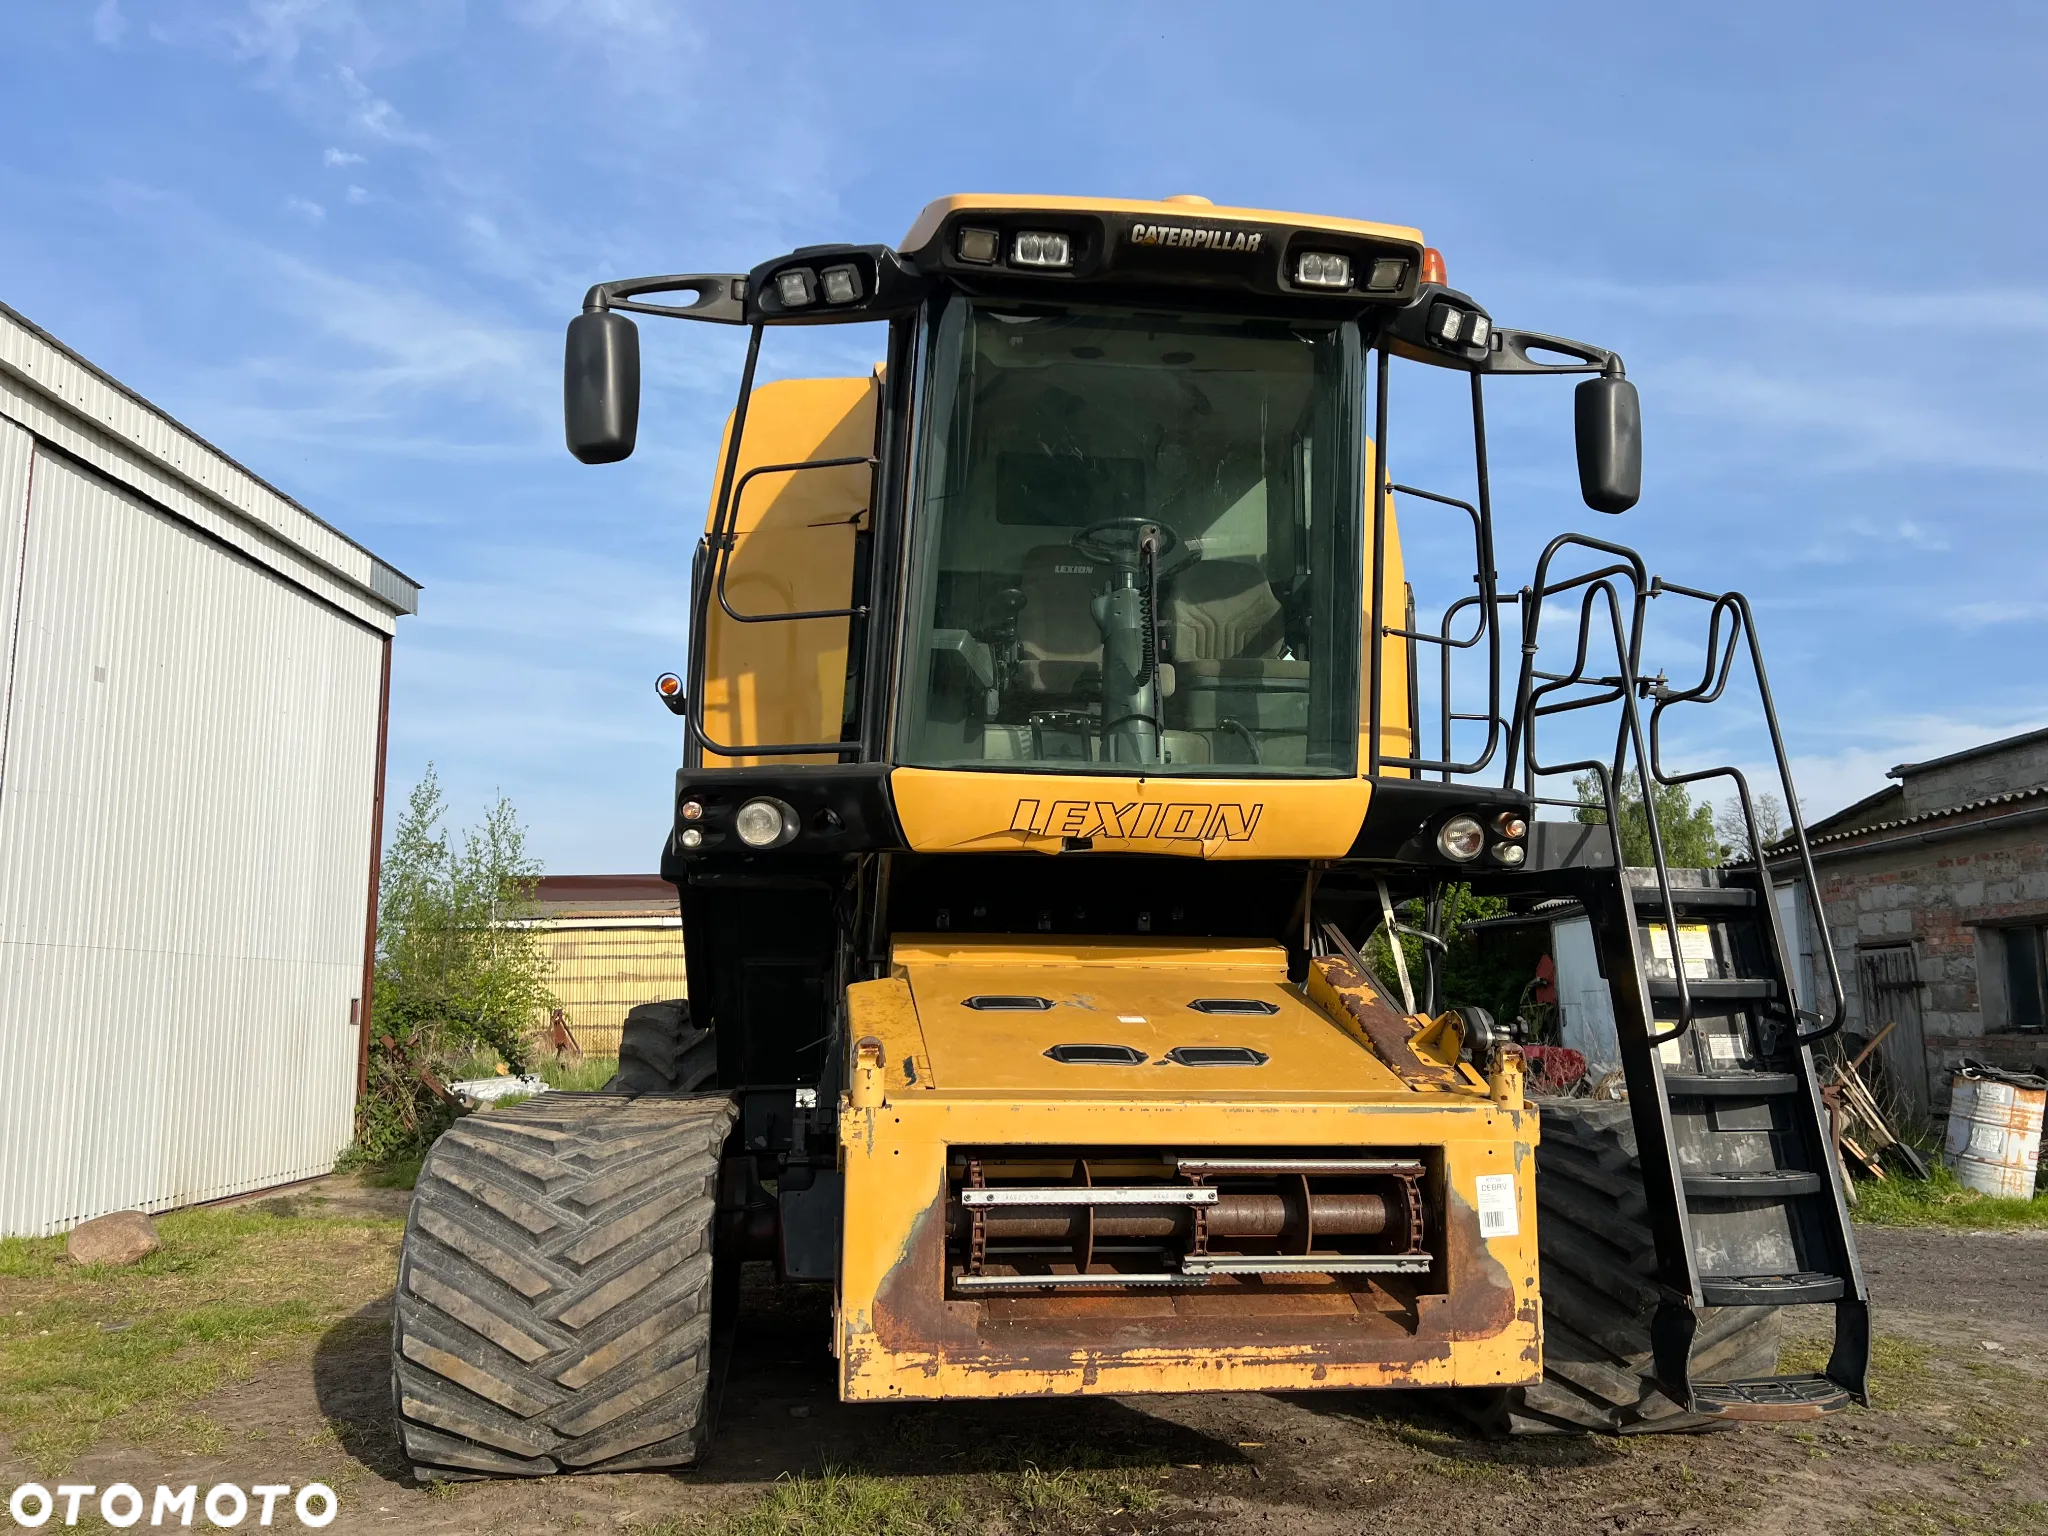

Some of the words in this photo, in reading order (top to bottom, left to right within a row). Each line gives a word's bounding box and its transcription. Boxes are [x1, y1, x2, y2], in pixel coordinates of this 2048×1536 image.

[1131, 223, 1262, 252] CATERPILLAR
[1054, 565, 1094, 574] LEXION
[1009, 798, 1264, 842] LEXION
